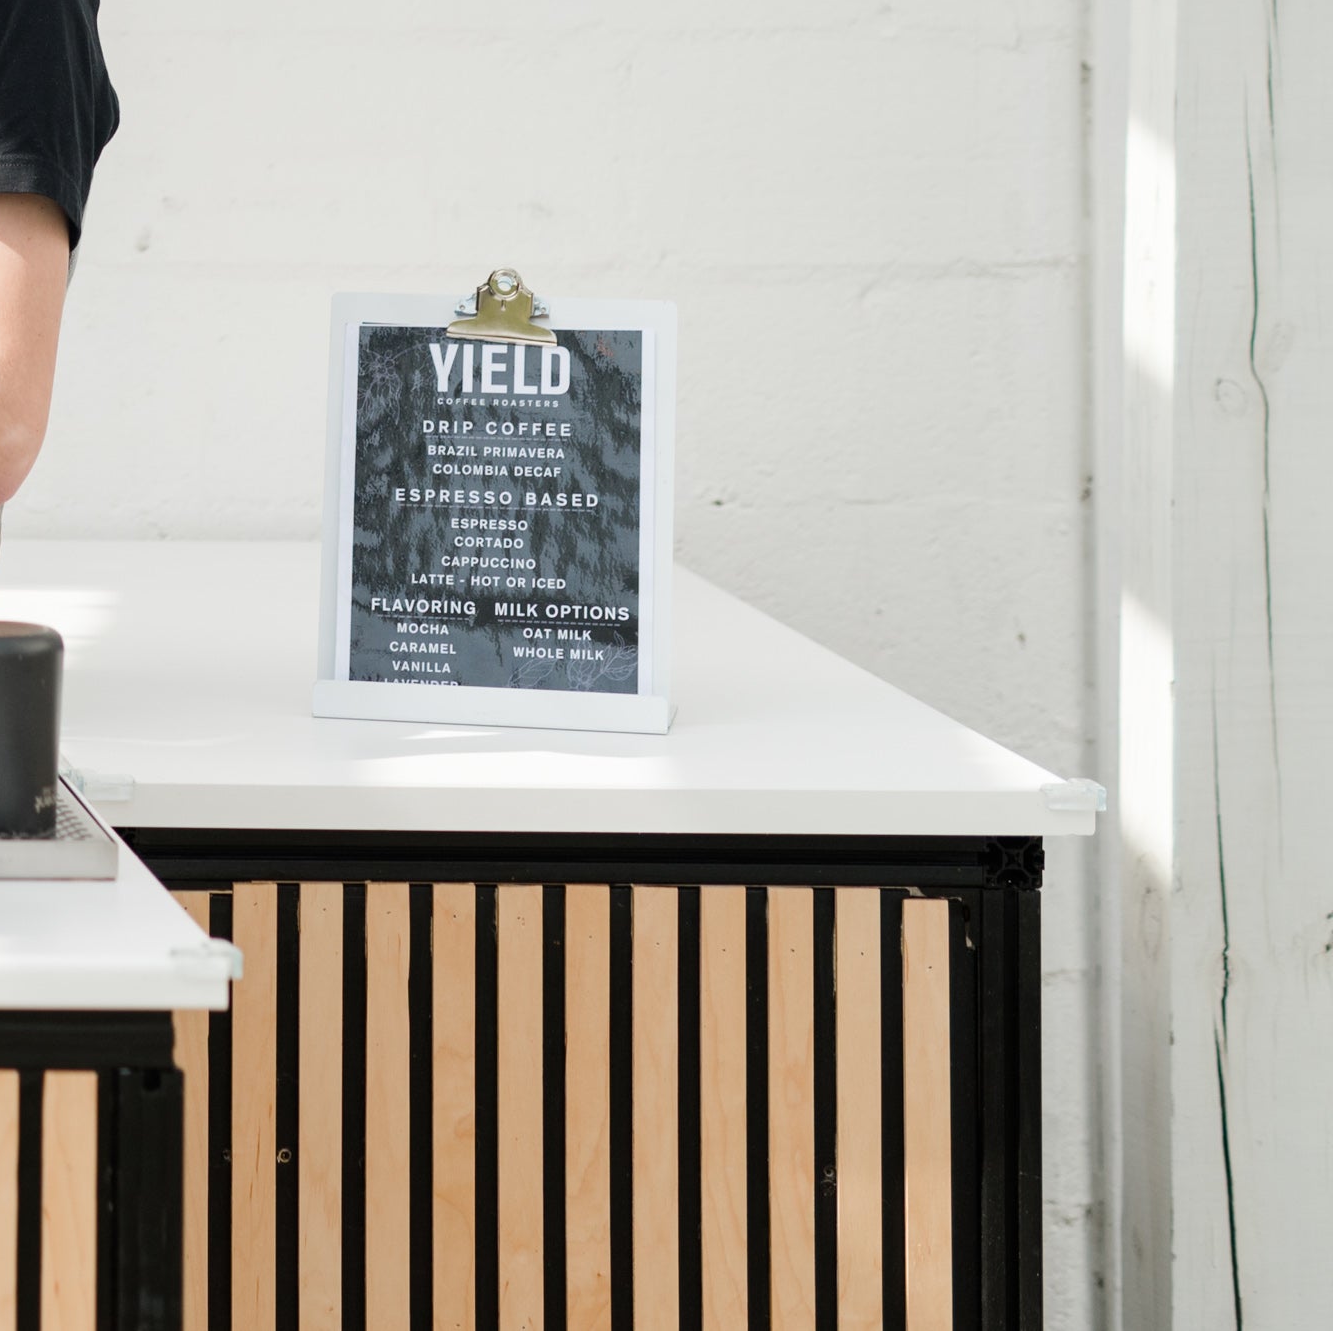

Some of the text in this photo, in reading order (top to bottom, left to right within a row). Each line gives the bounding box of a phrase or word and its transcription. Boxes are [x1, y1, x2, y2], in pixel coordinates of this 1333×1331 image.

[429, 342, 570, 394] YIELD
[493, 399, 558, 407] ROASTERS
[423, 420, 570, 436] DRIP COFFEE
[428, 445, 564, 458] BRAZIL PRIMAVERA
[433, 464, 561, 477] COLOMBIA DECAF
[396, 489, 598, 507] ESPRESSO BASED
[452, 518, 527, 530] ESPRESSO
[455, 537, 523, 548] CORTADO
[442, 556, 535, 569] CAPPUCCINO
[412, 574, 454, 585] LATTE
[472, 576, 500, 586] HOT
[506, 577, 525, 587] OR
[532, 578, 565, 589] ICED
[372, 598, 475, 614] FLAVORING
[495, 603, 629, 620] MILK OPTIONS
[397, 623, 448, 634] MOCHA
[523, 628, 591, 641] OAT MILK
[390, 642, 456, 654] CARAMEL
[514, 647, 603, 660] WHOLE MILK
[393, 661, 450, 672] VANILLA
